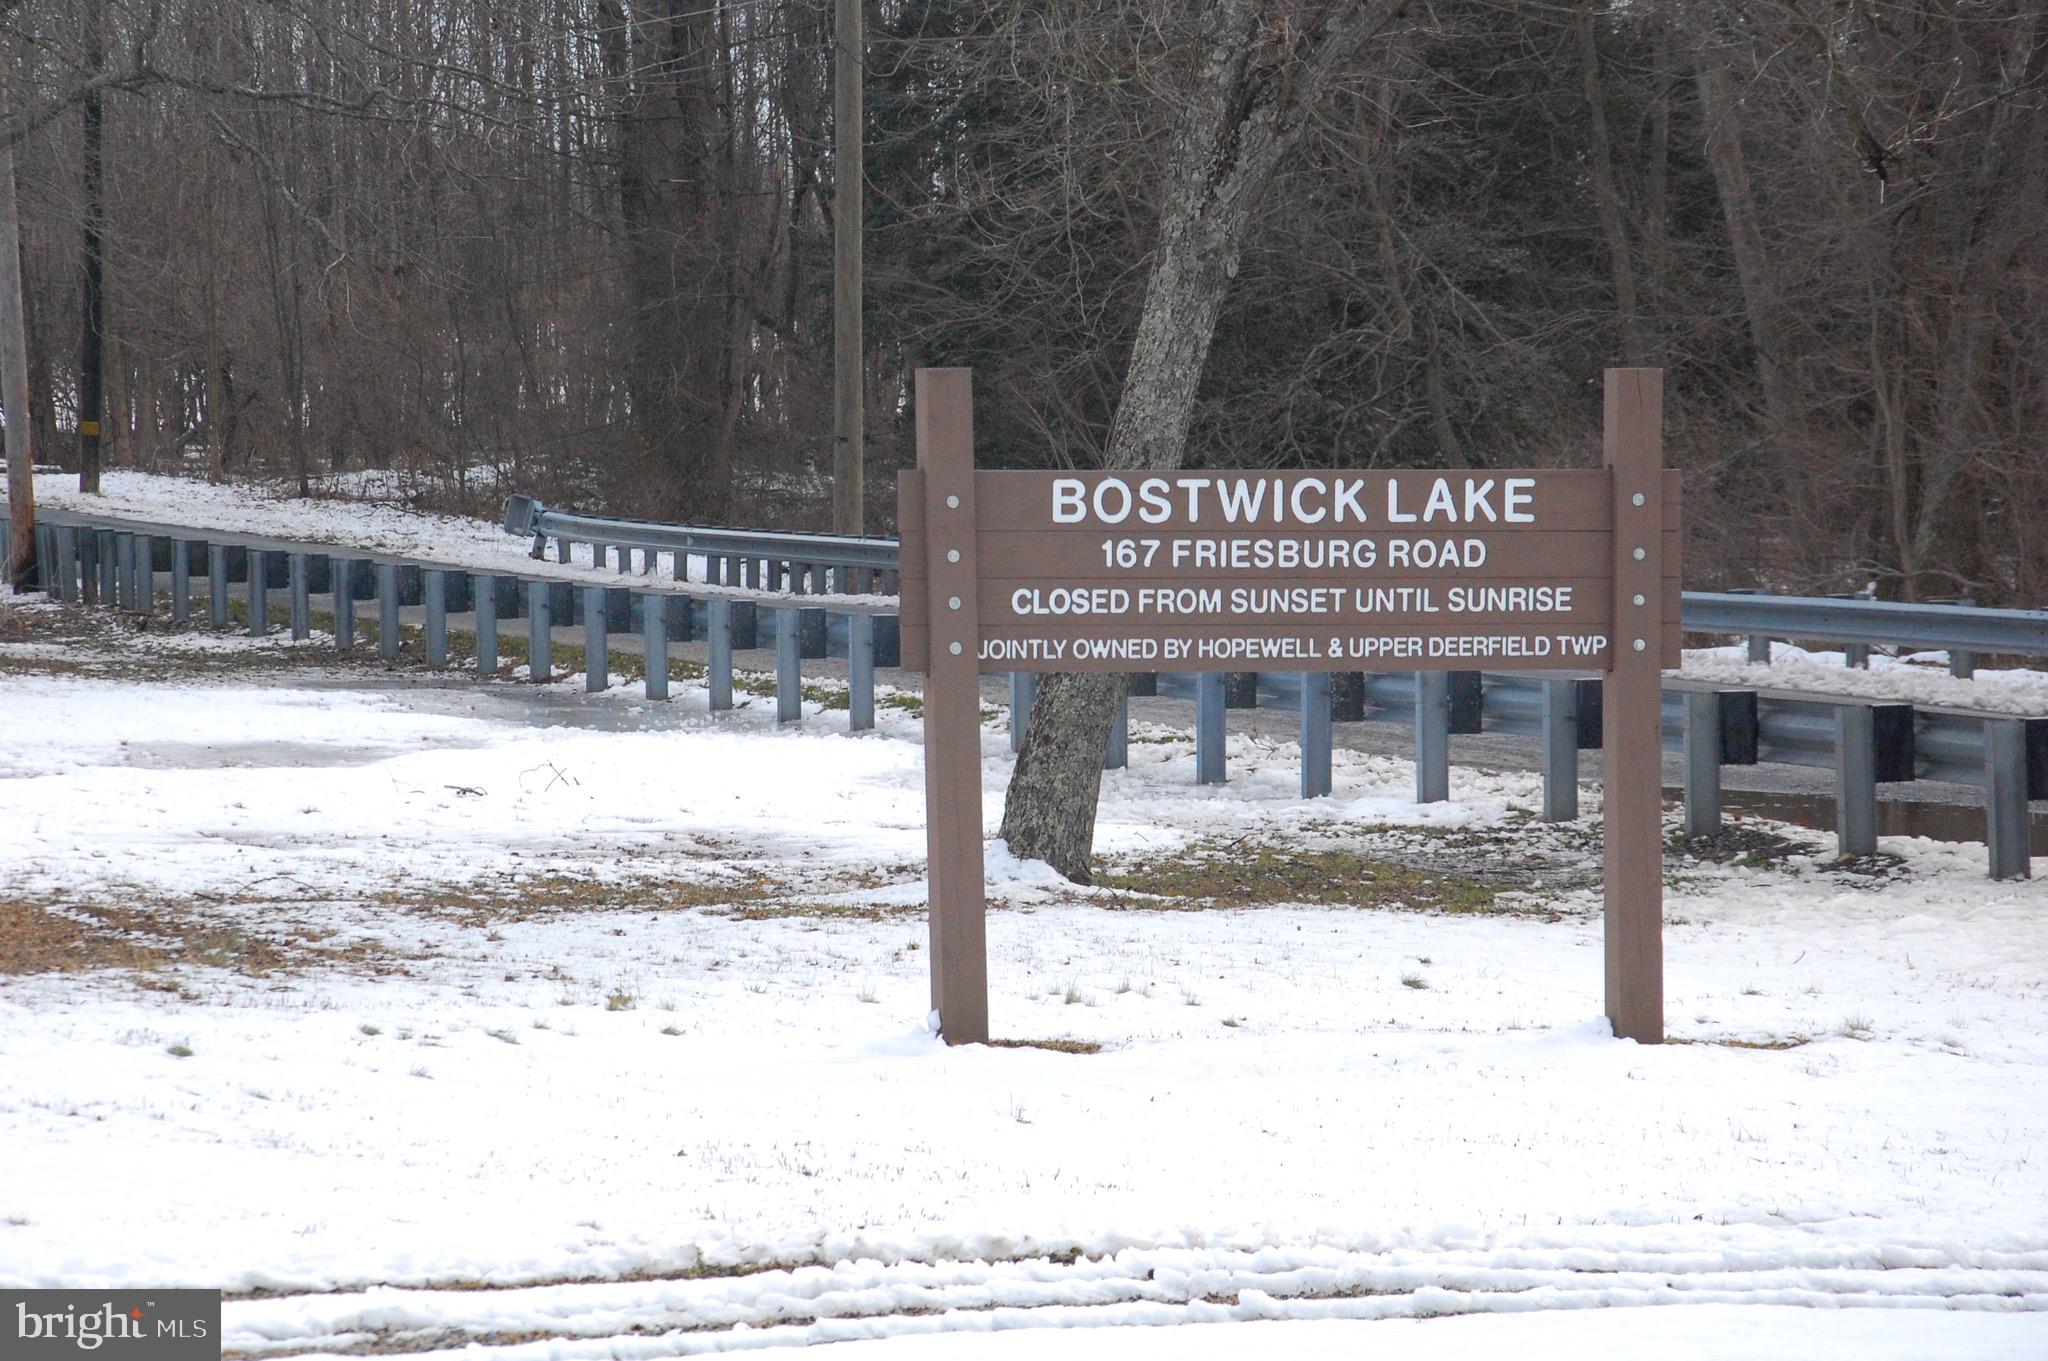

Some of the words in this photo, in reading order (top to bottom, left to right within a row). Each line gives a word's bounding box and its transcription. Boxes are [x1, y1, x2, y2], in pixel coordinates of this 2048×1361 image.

[1052, 477, 1367, 524] BOSTWICK
[1387, 477, 1536, 523] LAKE
[1101, 538, 1161, 569] 167
[1172, 538, 1377, 569] FRIESBURG
[1388, 538, 1486, 569] ROAD
[1011, 587, 1130, 615] CLOSED
[1138, 587, 1222, 614] FROM
[1230, 587, 1347, 614] SUNSET
[1355, 587, 1440, 613] UNTIL
[1447, 586, 1573, 613] SUNRISE
[977, 639, 1068, 660] JOINTLY
[1072, 638, 1158, 660] OWNED
[1163, 638, 1193, 659] BY
[1198, 637, 1323, 659] HOPEWELL
[1327, 637, 1343, 658] &
[1349, 637, 1423, 658] UPPER
[1428, 636, 1551, 657] DEERFIELD
[1556, 635, 1607, 656] TWP
